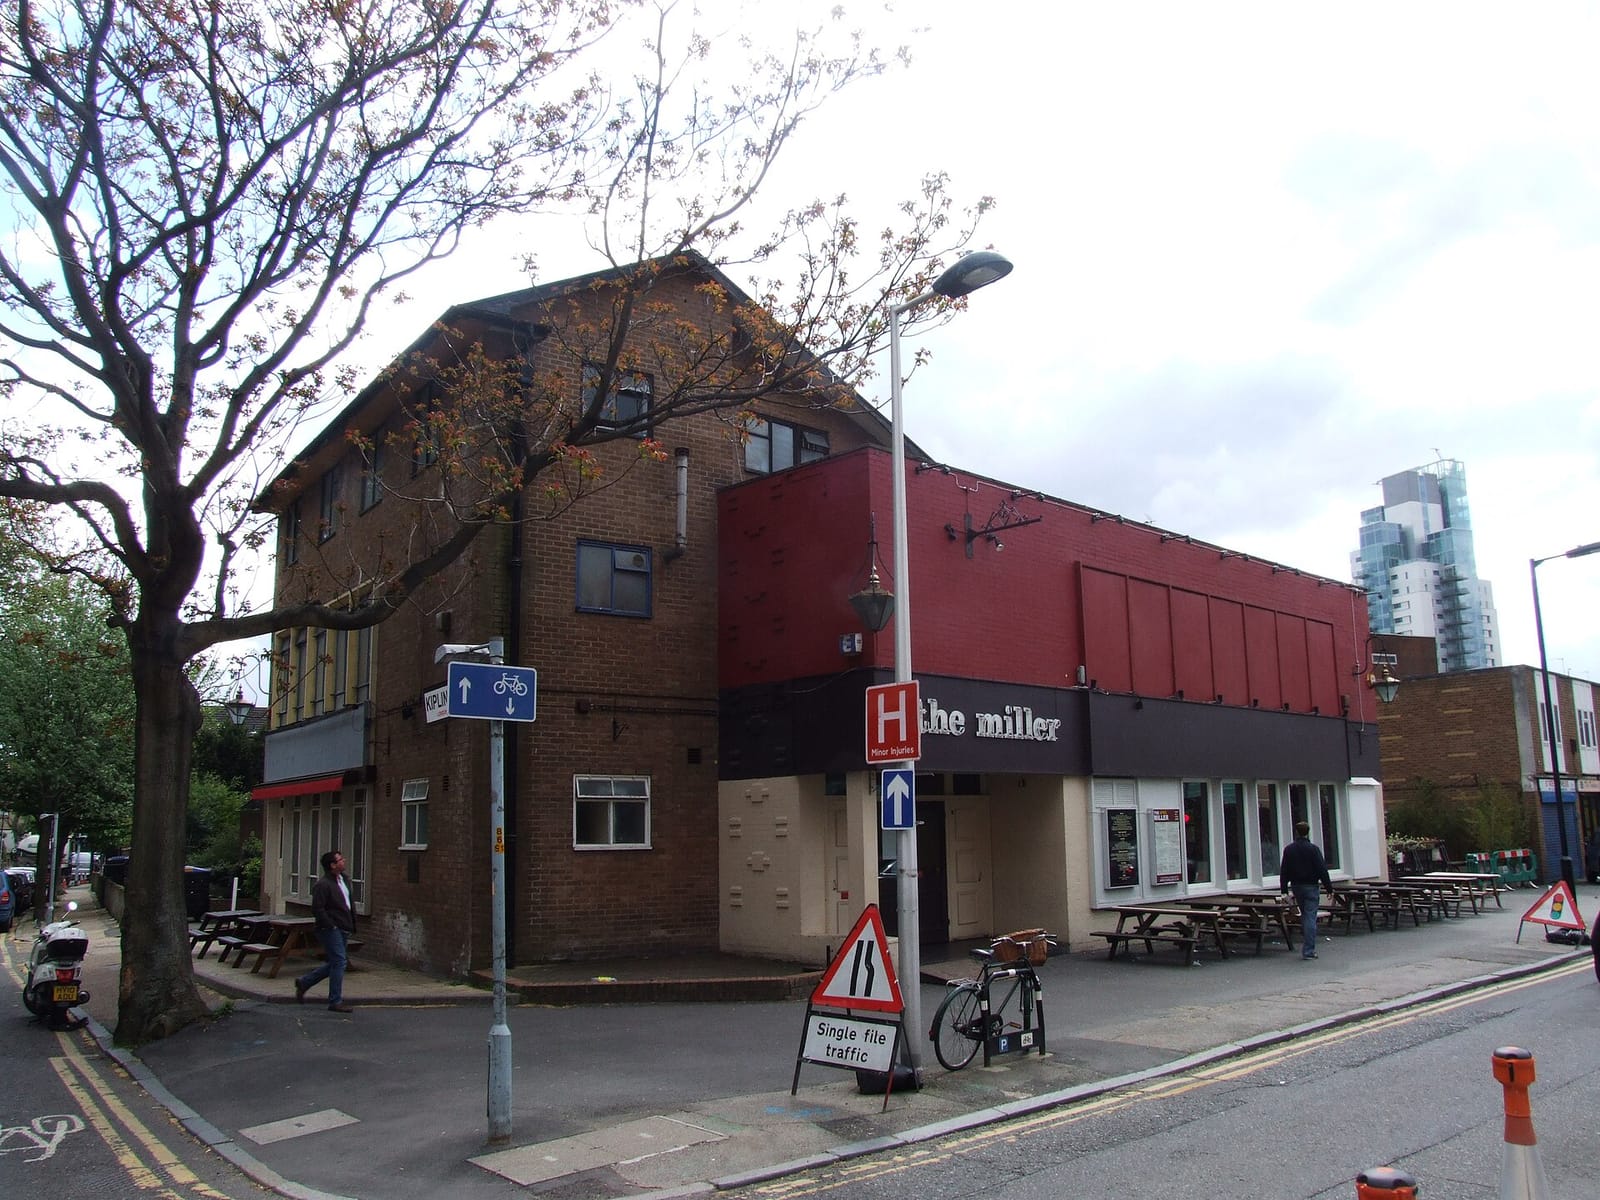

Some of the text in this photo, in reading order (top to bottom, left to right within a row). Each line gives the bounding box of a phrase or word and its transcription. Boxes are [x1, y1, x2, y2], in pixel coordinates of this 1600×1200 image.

[877, 690, 907, 744] H
[919, 698, 1061, 742] the miller
[871, 745, 914, 757] Minor Injuries
[816, 1022, 886, 1045] Single file
[826, 1043, 869, 1063] traffic
[1001, 1039, 1008, 1051] P
